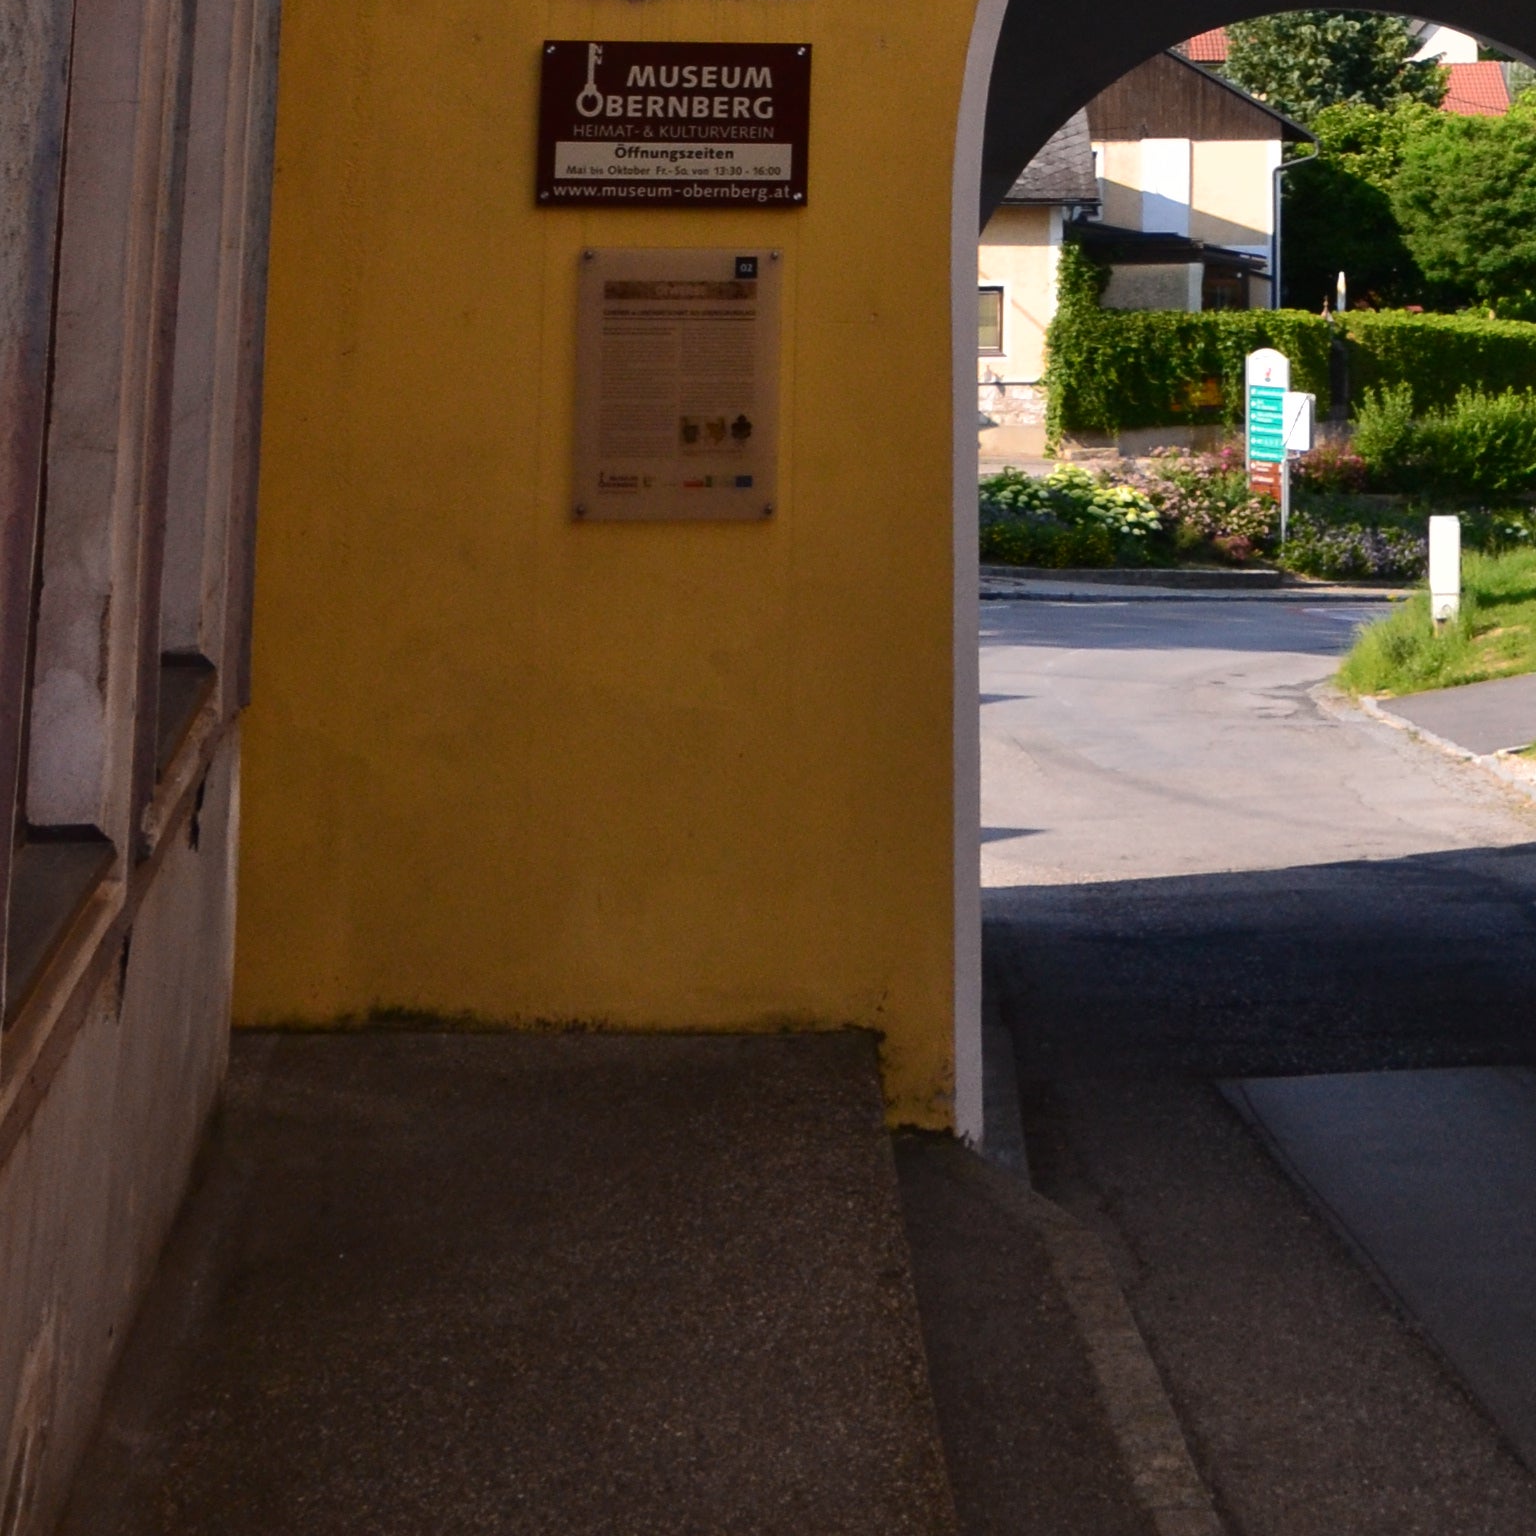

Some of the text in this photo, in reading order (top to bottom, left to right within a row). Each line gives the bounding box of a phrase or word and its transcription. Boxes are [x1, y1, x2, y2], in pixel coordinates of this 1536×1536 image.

[626, 65, 773, 89] MUSEUM
[575, 90, 774, 119] OBERNBERG
[572, 124, 775, 140] HEIMAT- & KULTURVEREIN
[614, 143, 735, 161] Öffnungszeiten
[607, 165, 650, 176] Oktober
[714, 166, 743, 176] 13:30
[553, 183, 791, 203] www.museum-obernberg.at
[740, 263, 753, 273] 02
